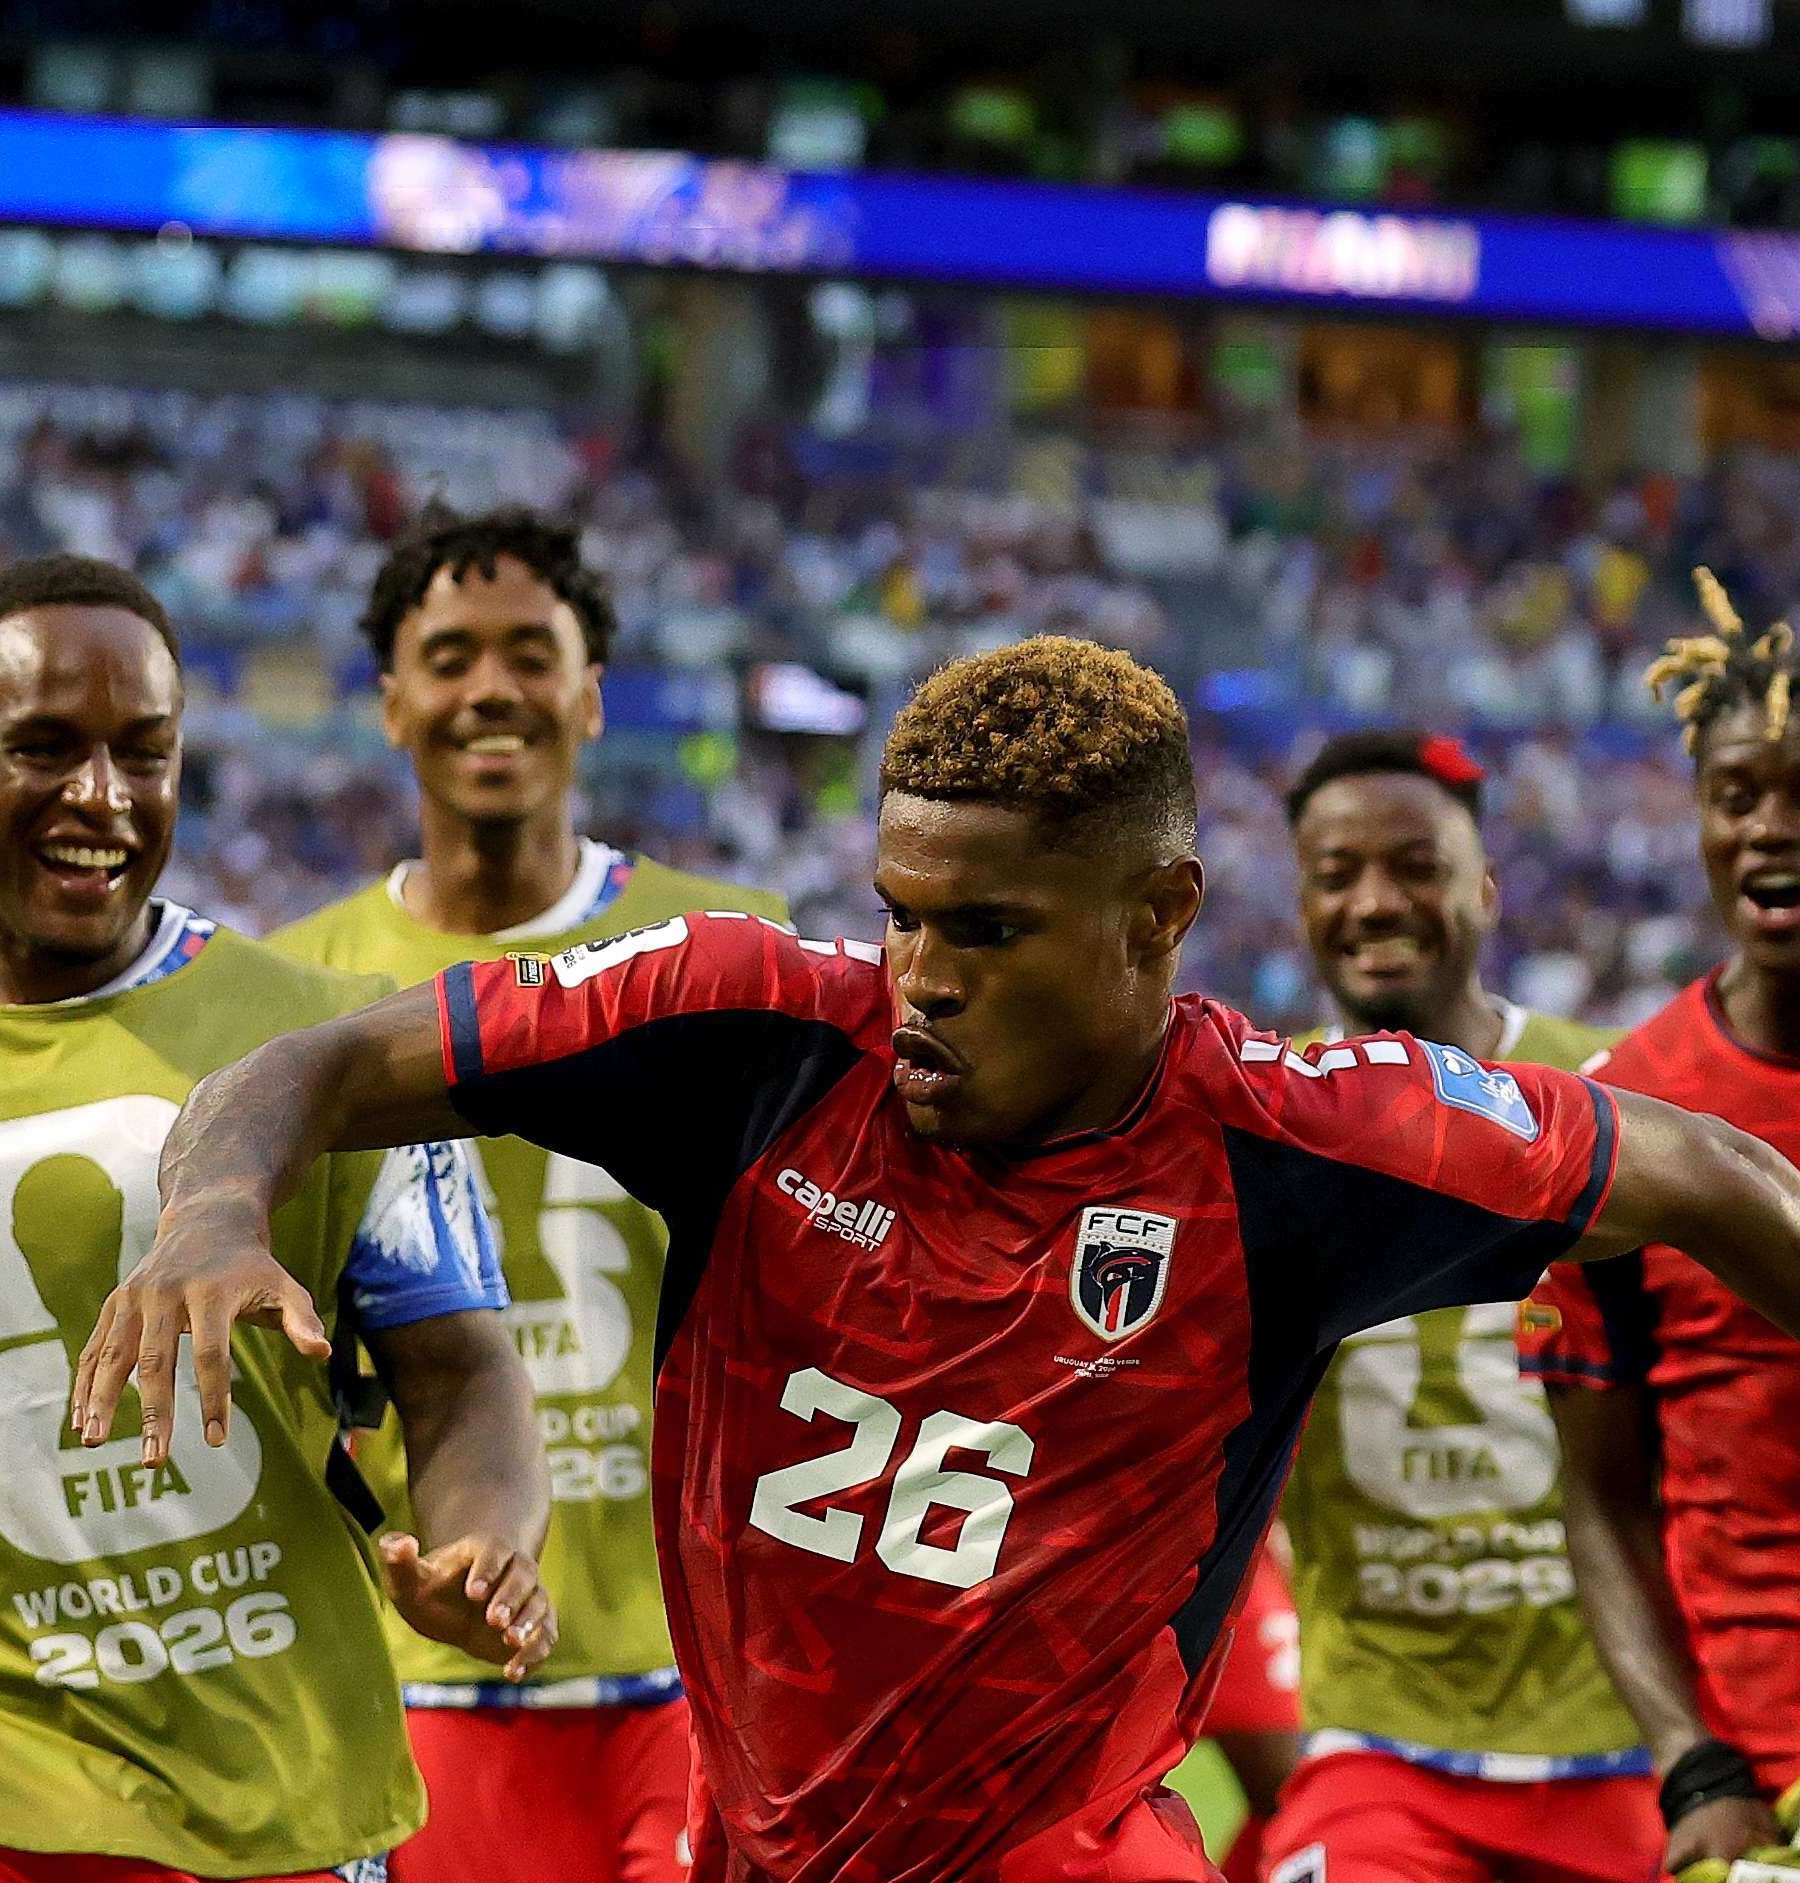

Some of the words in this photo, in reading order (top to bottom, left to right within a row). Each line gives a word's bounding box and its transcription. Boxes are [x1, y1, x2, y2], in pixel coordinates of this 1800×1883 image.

[776, 1168, 896, 1243] capelli
[813, 1216, 882, 1252] SPORT
[1088, 1213, 1169, 1237] FCF
[62, 1456, 193, 1519] FIFA
[749, 1366, 1037, 1590] 26
[12, 1567, 182, 1628] WORLD
[190, 1542, 283, 1595] CUP
[29, 1591, 298, 1690] 2026
